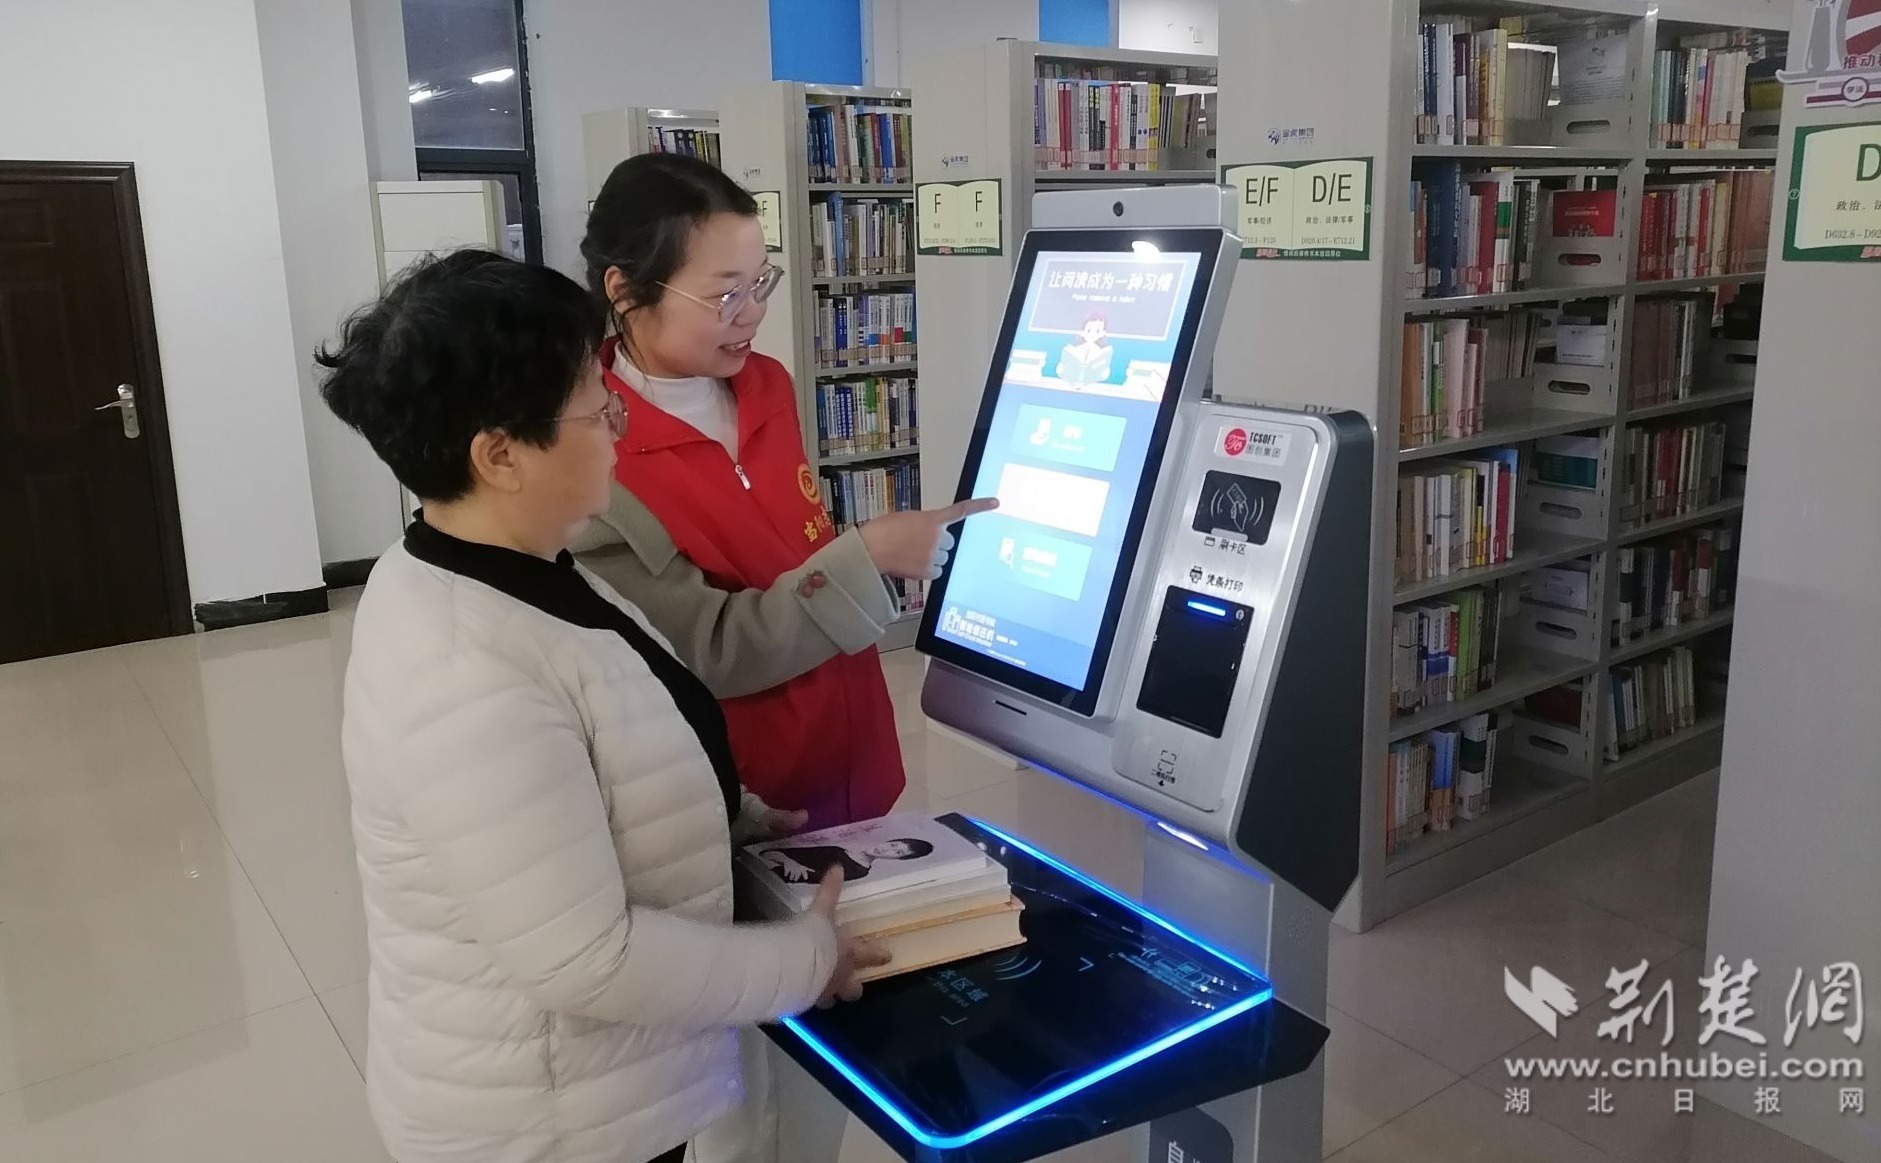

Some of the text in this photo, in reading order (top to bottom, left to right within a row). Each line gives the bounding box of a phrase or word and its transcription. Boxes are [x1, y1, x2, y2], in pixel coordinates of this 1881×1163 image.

[1245, 175, 1279, 207] E/F
[1312, 173, 1352, 206] D/E
[934, 193, 942, 214] F
[975, 191, 983, 213] F
[1049, 270, 1174, 292] 让阅读成为一种习惯
[1249, 431, 1277, 446] TCSOFT
[1220, 538, 1247, 556] 刷卡区
[1206, 573, 1244, 592] 凭条打印
